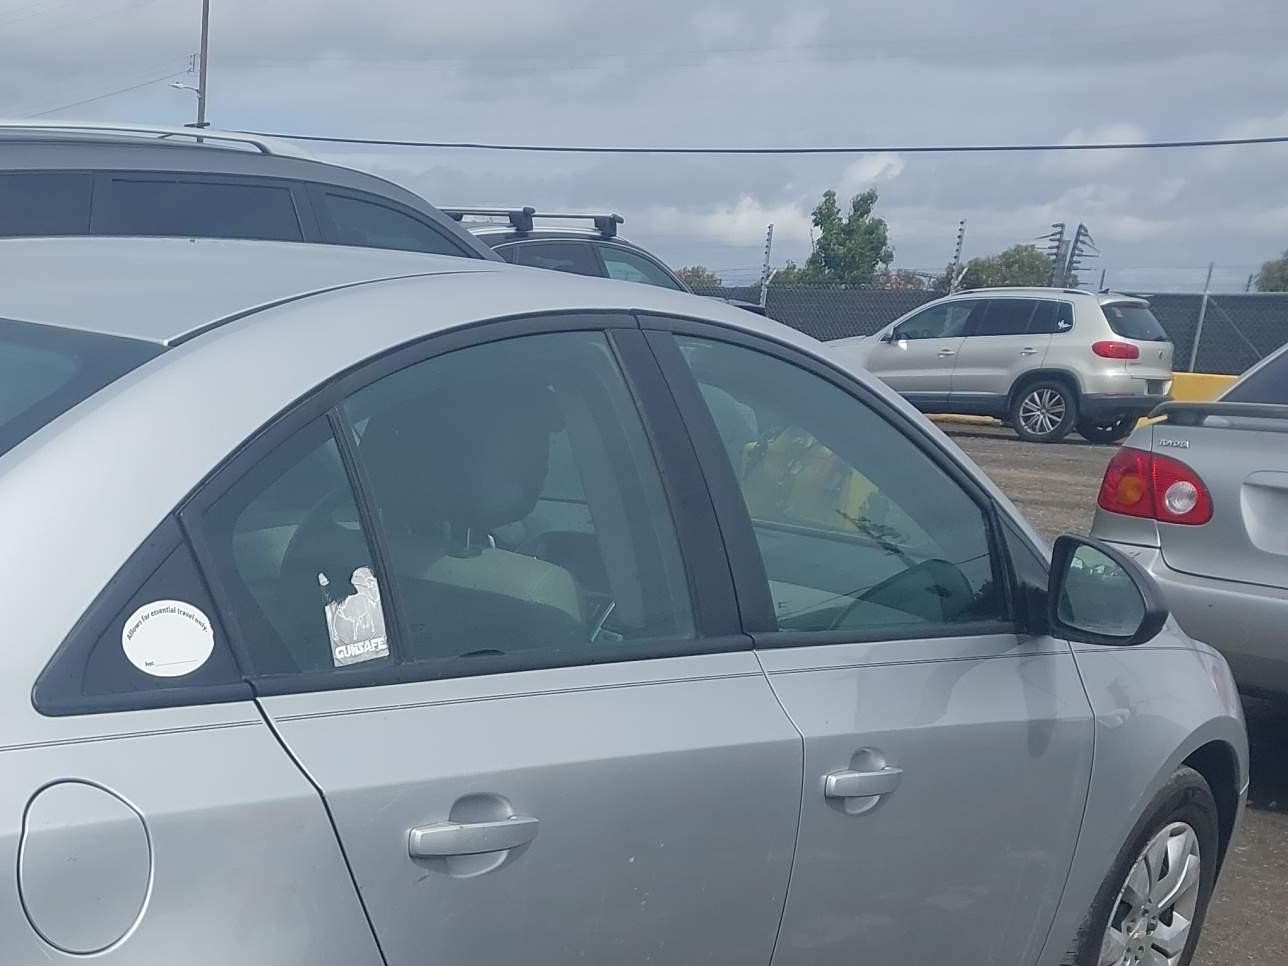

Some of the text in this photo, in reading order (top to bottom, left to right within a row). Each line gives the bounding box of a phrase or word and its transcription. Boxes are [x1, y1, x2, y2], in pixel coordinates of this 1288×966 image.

[127, 620, 143, 640] Allows
[141, 613, 151, 622] for
[150, 606, 176, 617] essential
[177, 607, 195, 620] travel
